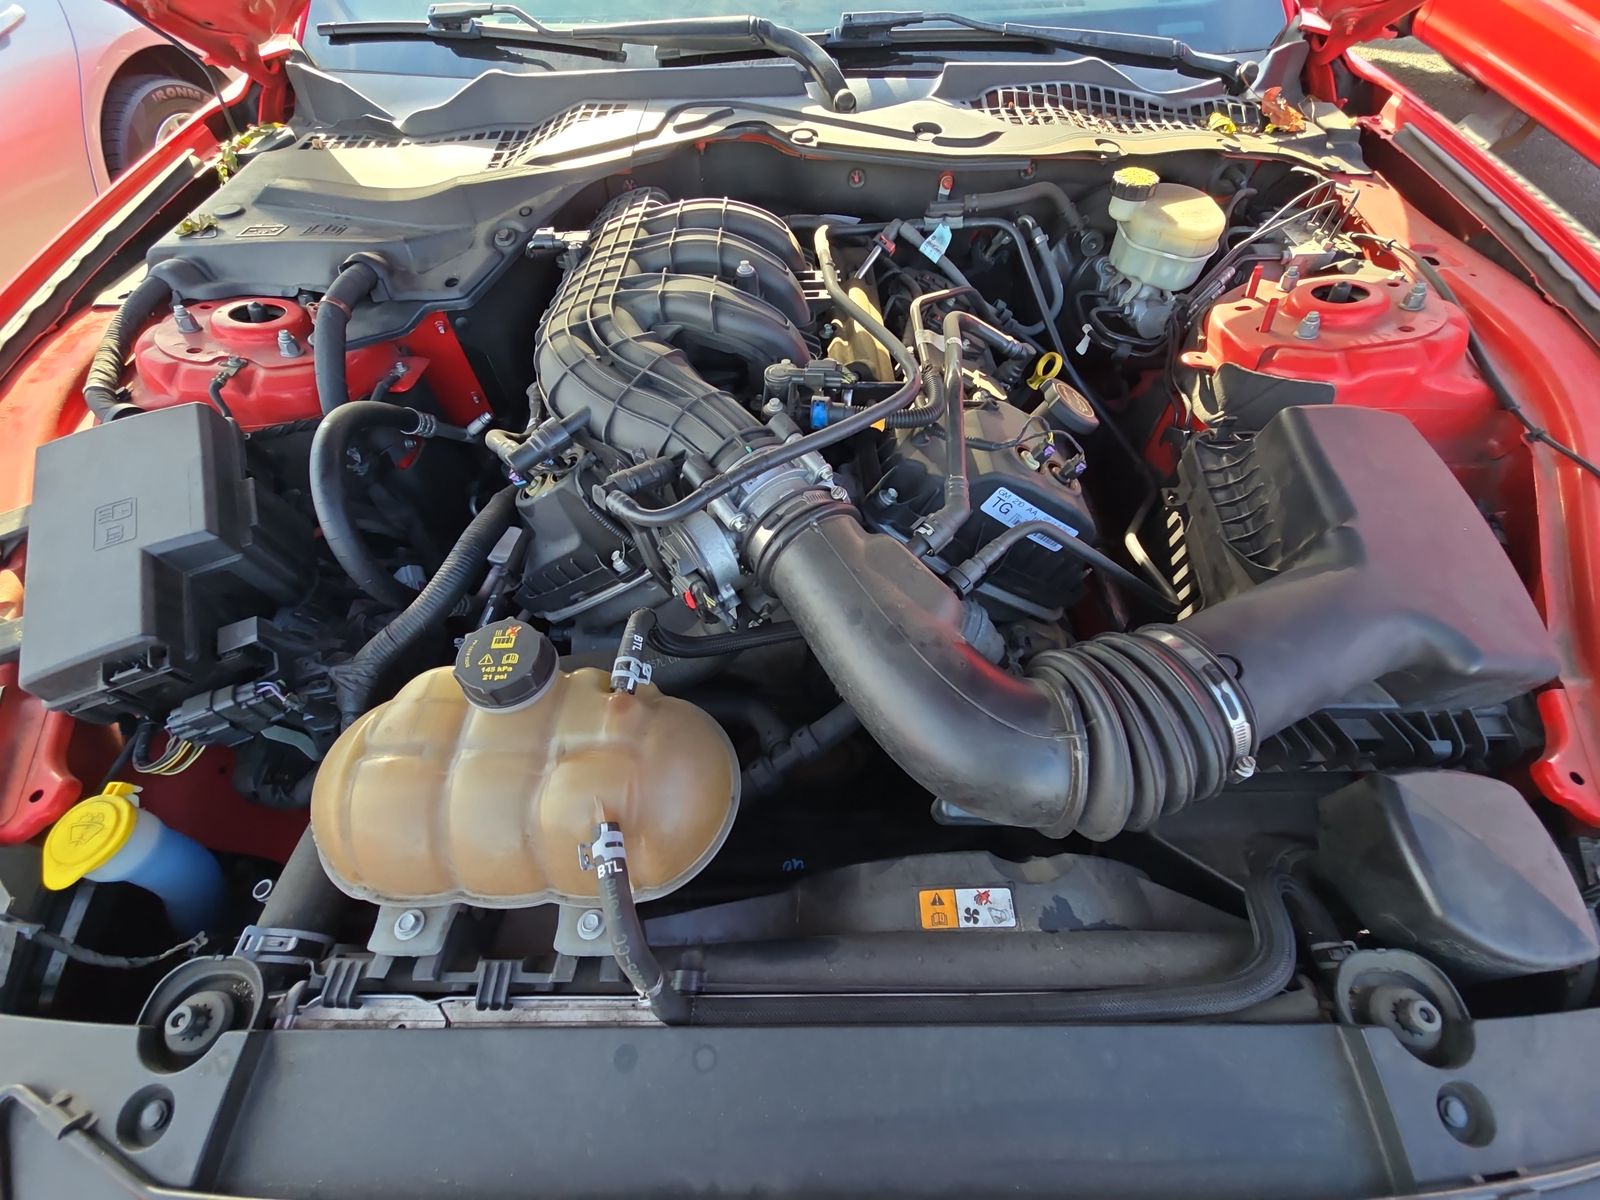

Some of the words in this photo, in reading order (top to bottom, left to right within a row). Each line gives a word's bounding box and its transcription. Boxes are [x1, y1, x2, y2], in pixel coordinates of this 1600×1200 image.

[992, 496, 1013, 515] TG
[1026, 507, 1038, 517] AA
[632, 634, 644, 651] BTL
[497, 665, 513, 673] kPa
[494, 673, 508, 681] psi
[597, 860, 623, 879] BTL
